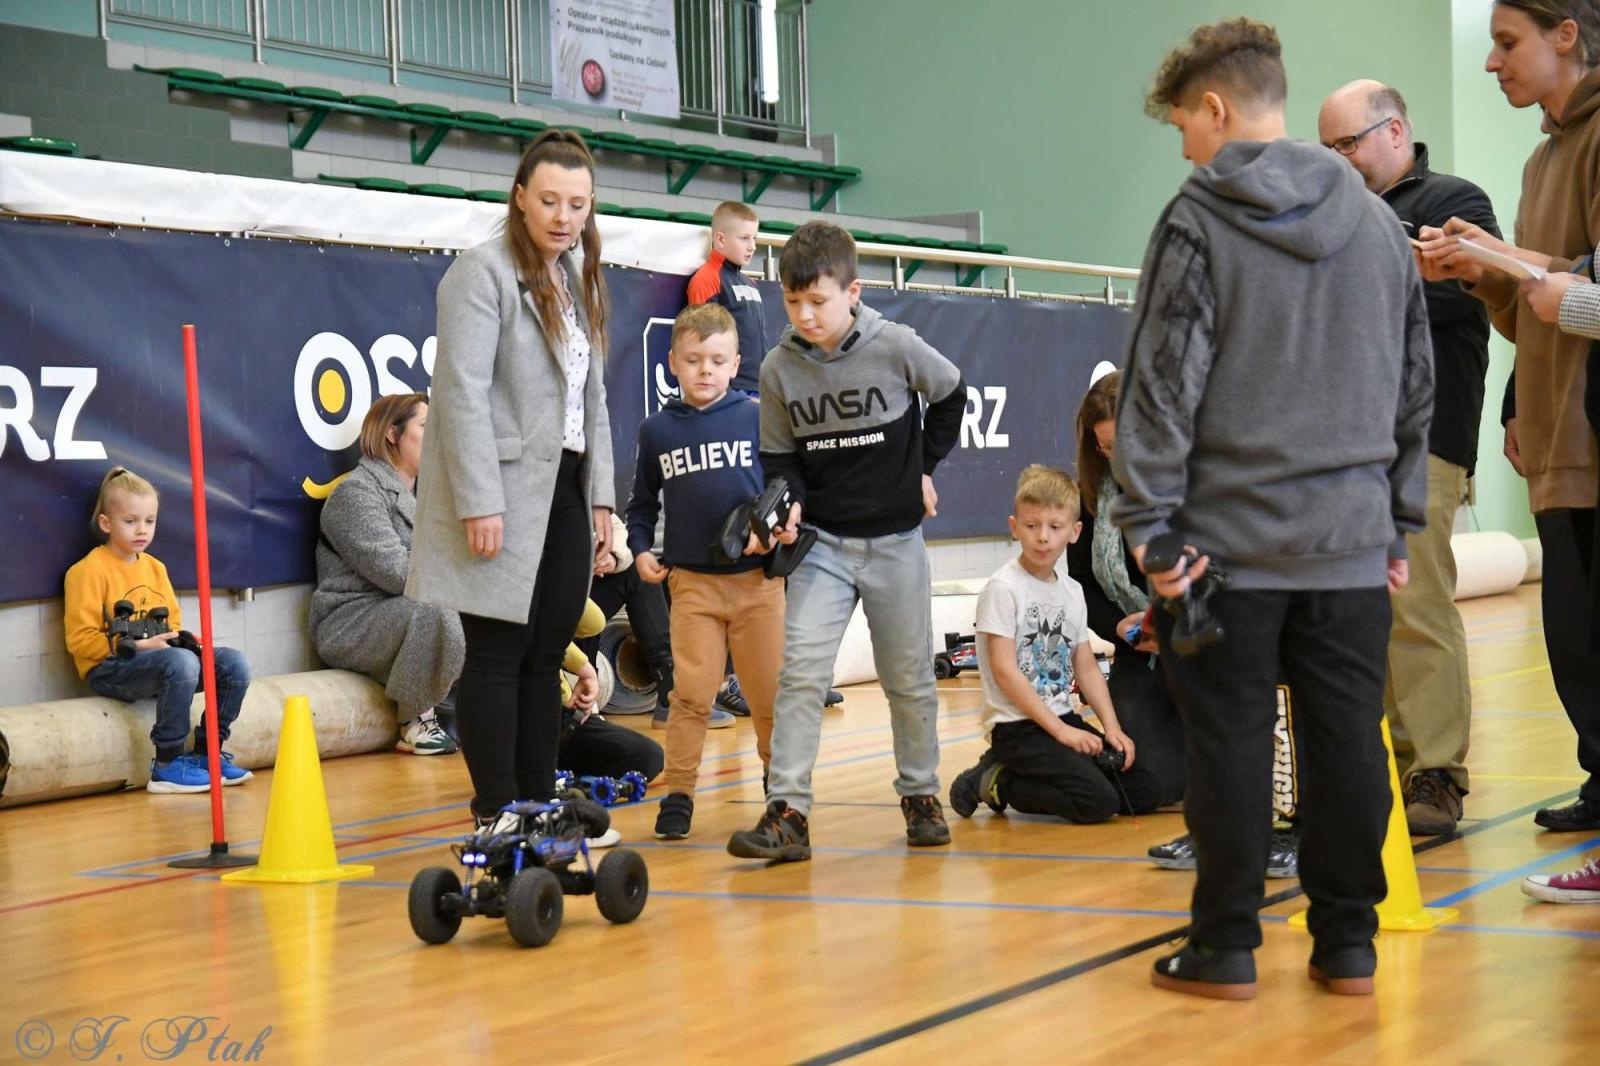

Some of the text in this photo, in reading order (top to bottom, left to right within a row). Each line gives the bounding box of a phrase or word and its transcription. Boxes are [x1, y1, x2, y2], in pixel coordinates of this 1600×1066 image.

[788, 386, 888, 428] NASA
[659, 440, 753, 480] BELIEVE
[806, 432, 885, 451] SPACE MISSION
